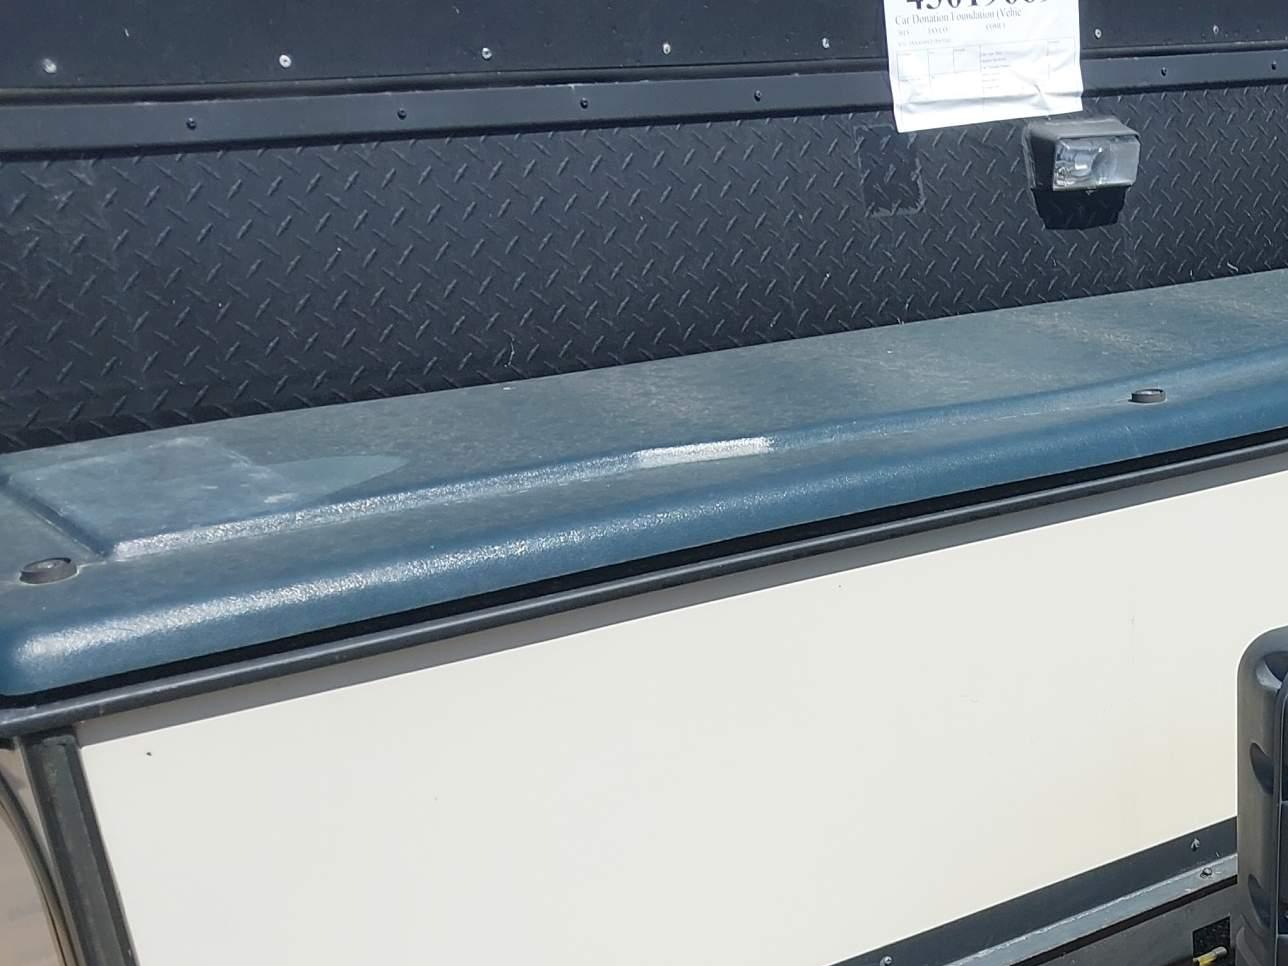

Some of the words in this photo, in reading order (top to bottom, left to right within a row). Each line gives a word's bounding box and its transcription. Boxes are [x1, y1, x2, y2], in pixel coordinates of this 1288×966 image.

[895, 15, 910, 26] Car
[912, 13, 949, 24] Donation
[950, 10, 994, 22] Foundation
